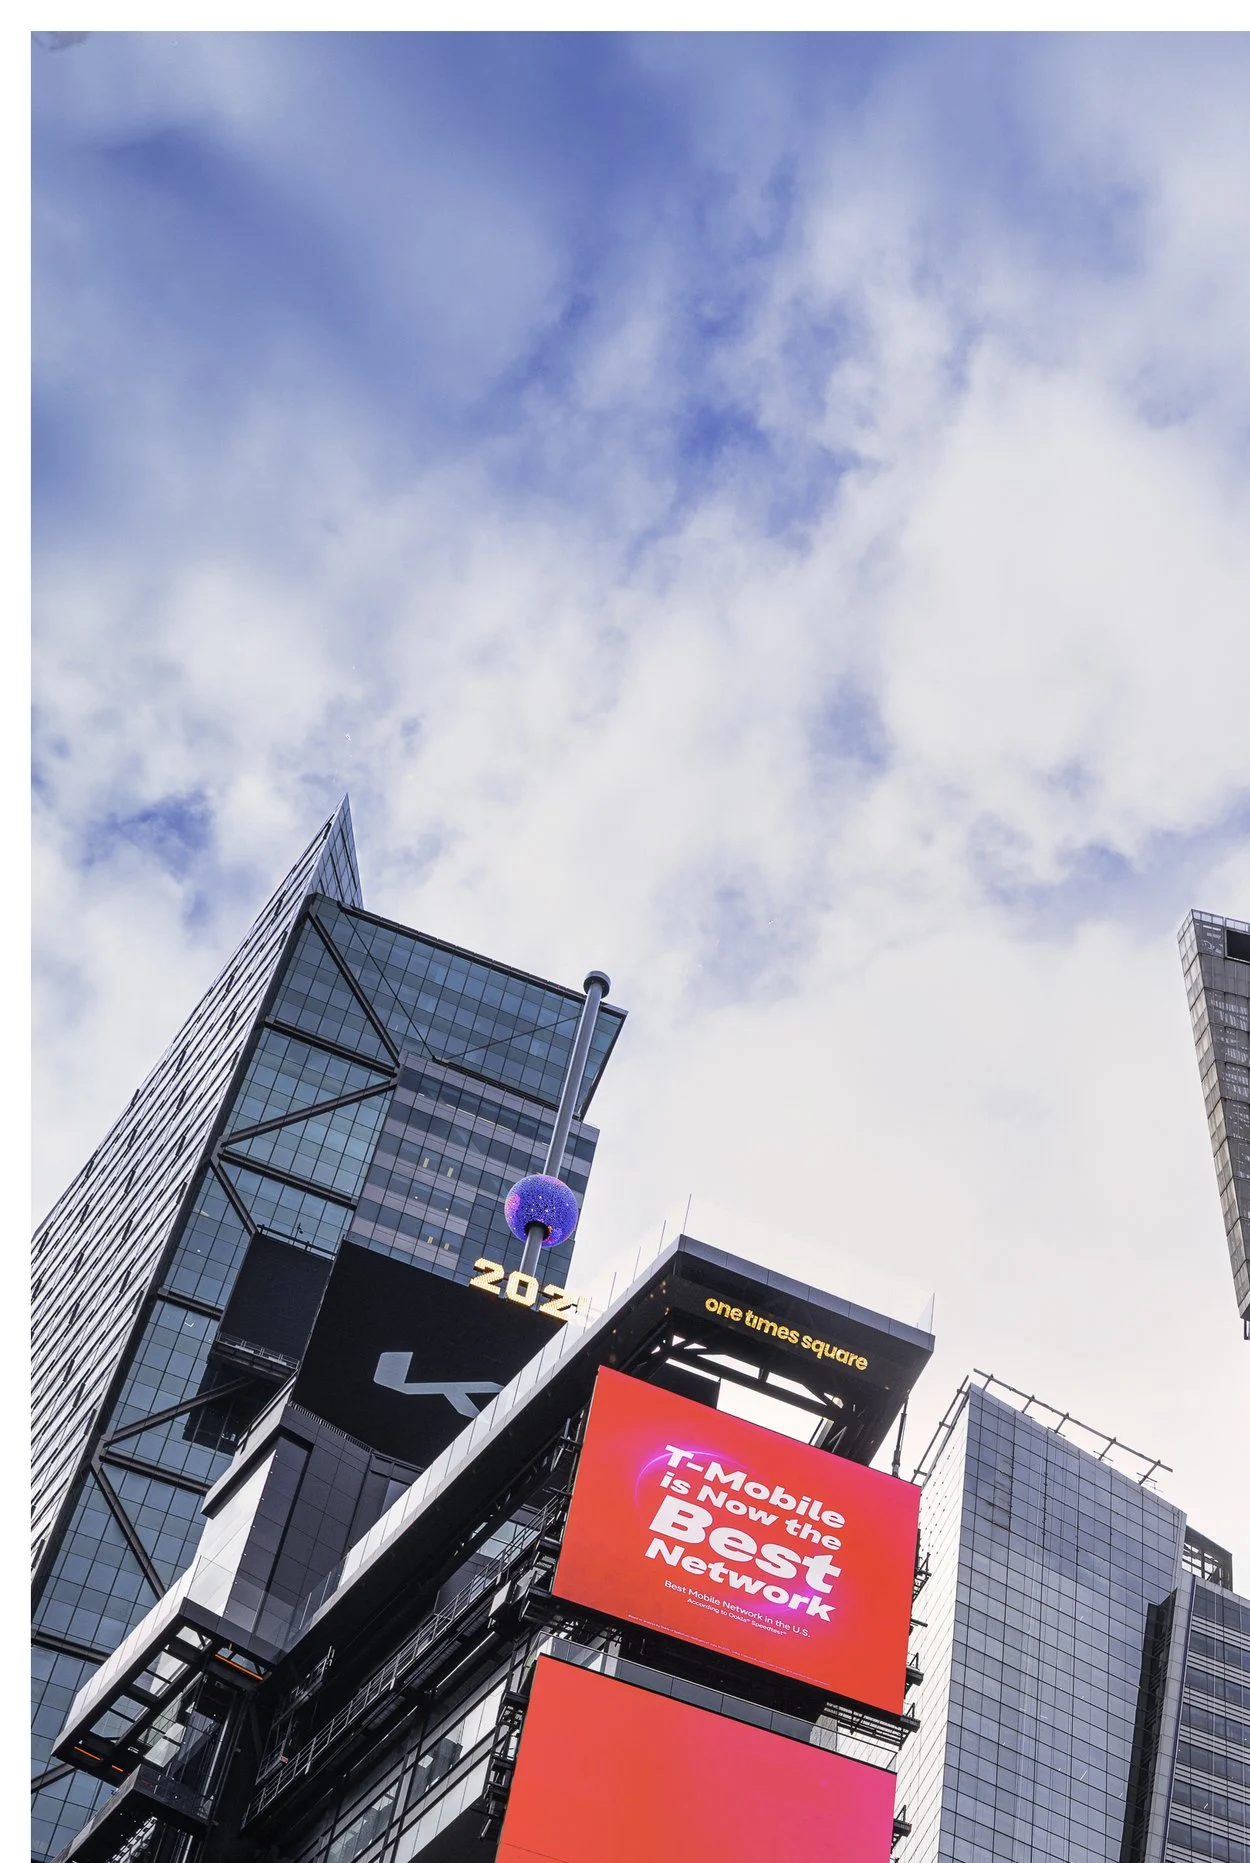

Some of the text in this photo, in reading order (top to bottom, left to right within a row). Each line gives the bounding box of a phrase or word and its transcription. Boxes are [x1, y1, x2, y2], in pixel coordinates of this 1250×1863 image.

[705, 1297, 869, 1371] one times square
[660, 1471, 842, 1550] is Now the
[665, 1444, 846, 1529] T-Mobile
[645, 1537, 836, 1622] Network
[649, 1494, 842, 1594] Best
[664, 1580, 811, 1638] Best Mobile Network in the U.S.
[687, 1598, 720, 1614] According
